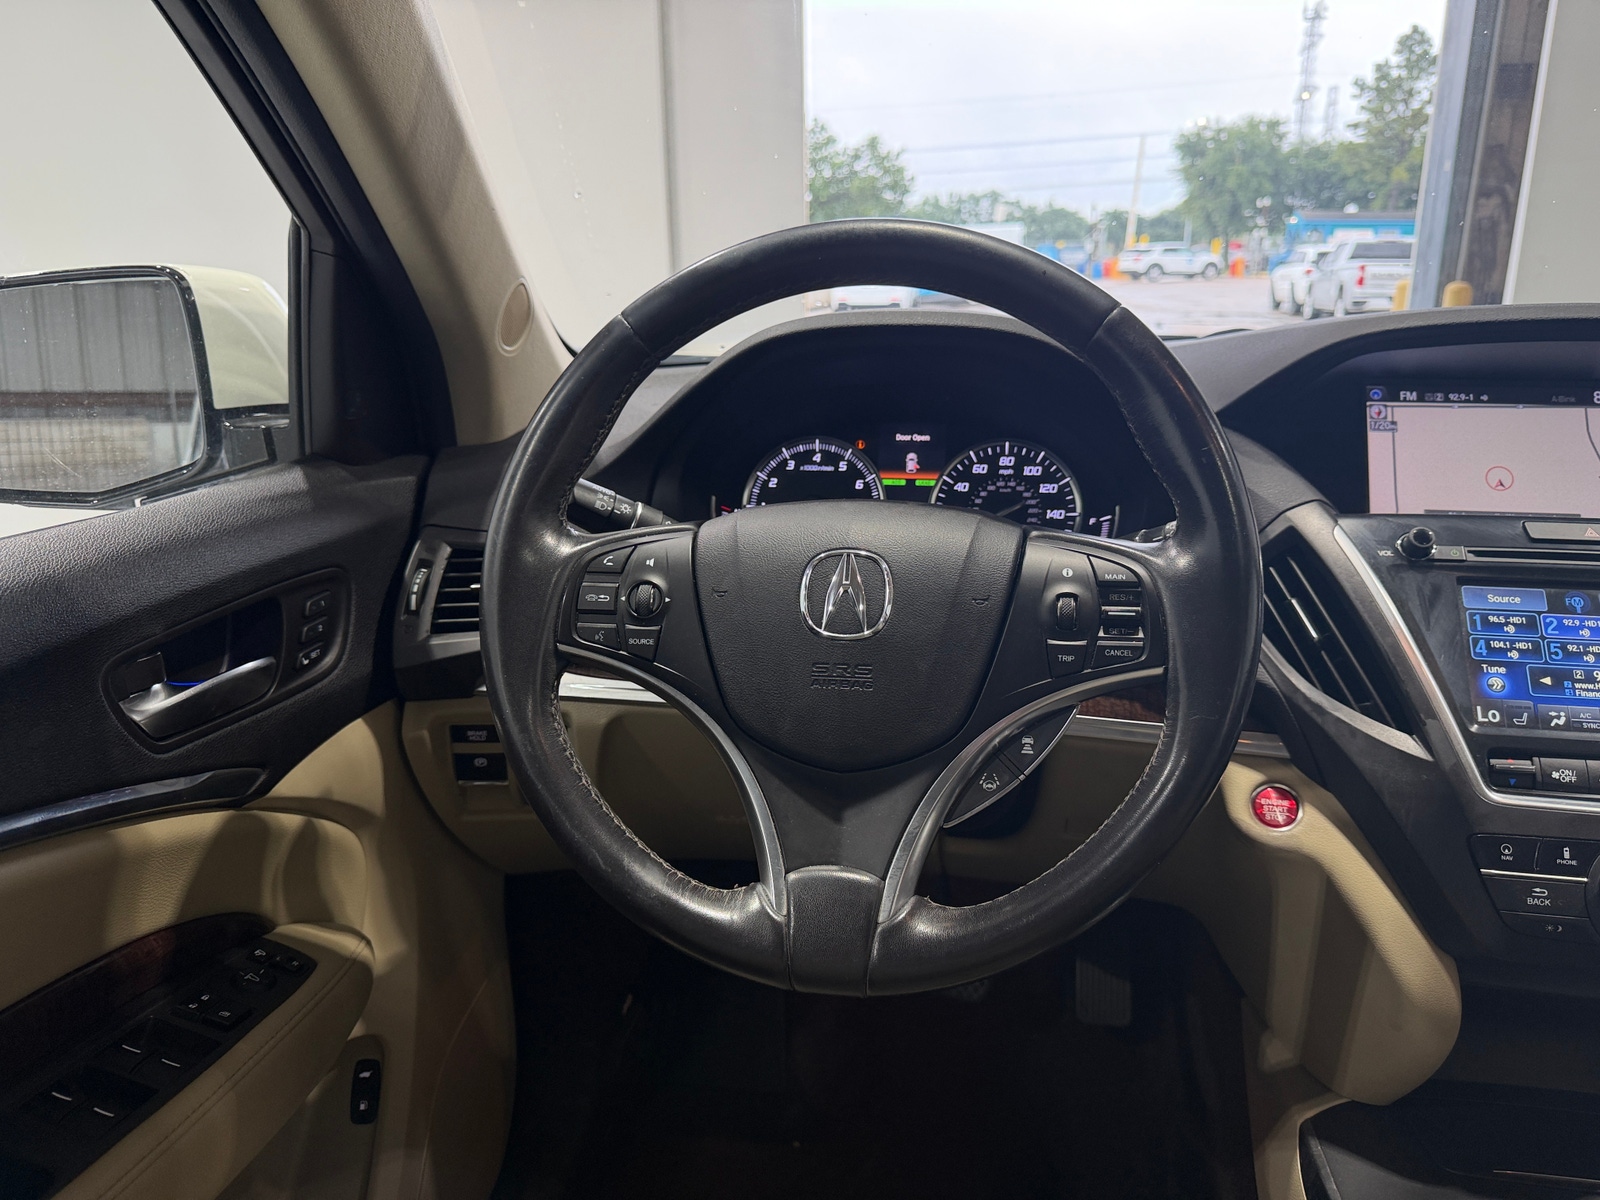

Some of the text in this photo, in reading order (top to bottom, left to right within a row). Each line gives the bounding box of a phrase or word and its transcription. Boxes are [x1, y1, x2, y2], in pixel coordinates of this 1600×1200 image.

[1400, 391, 1417, 401] FM
[895, 433, 931, 442] Door Open
[812, 453, 822, 463] 4
[999, 456, 1015, 466] 80
[786, 460, 796, 471] 3
[838, 461, 848, 471] 5
[972, 464, 988, 474] 60
[1023, 466, 1042, 476] 100
[768, 477, 778, 488] 2
[855, 480, 864, 489] 6
[954, 482, 969, 492] 40
[1039, 484, 1058, 494] 120
[1046, 509, 1065, 520] 140
[1089, 518, 1097, 526] F
[1487, 594, 1521, 604] Source
[1472, 614, 1526, 631] 1 96.5 -HD1
[1545, 617, 1559, 634] 2
[1562, 618, 1580, 627] 92.9
[1475, 639, 1533, 656] 4 104.1 -HD1
[1550, 642, 1563, 660] 5
[1566, 644, 1584, 652] 92.1
[1057, 654, 1075, 662] TRIP
[811, 662, 873, 678] SRS
[1481, 664, 1507, 674] Tune
[810, 680, 873, 691] AIRBAG
[1582, 722, 1600, 730] SYNC
[1556, 858, 1578, 866] PHONE
[1527, 898, 1551, 906] BACK
